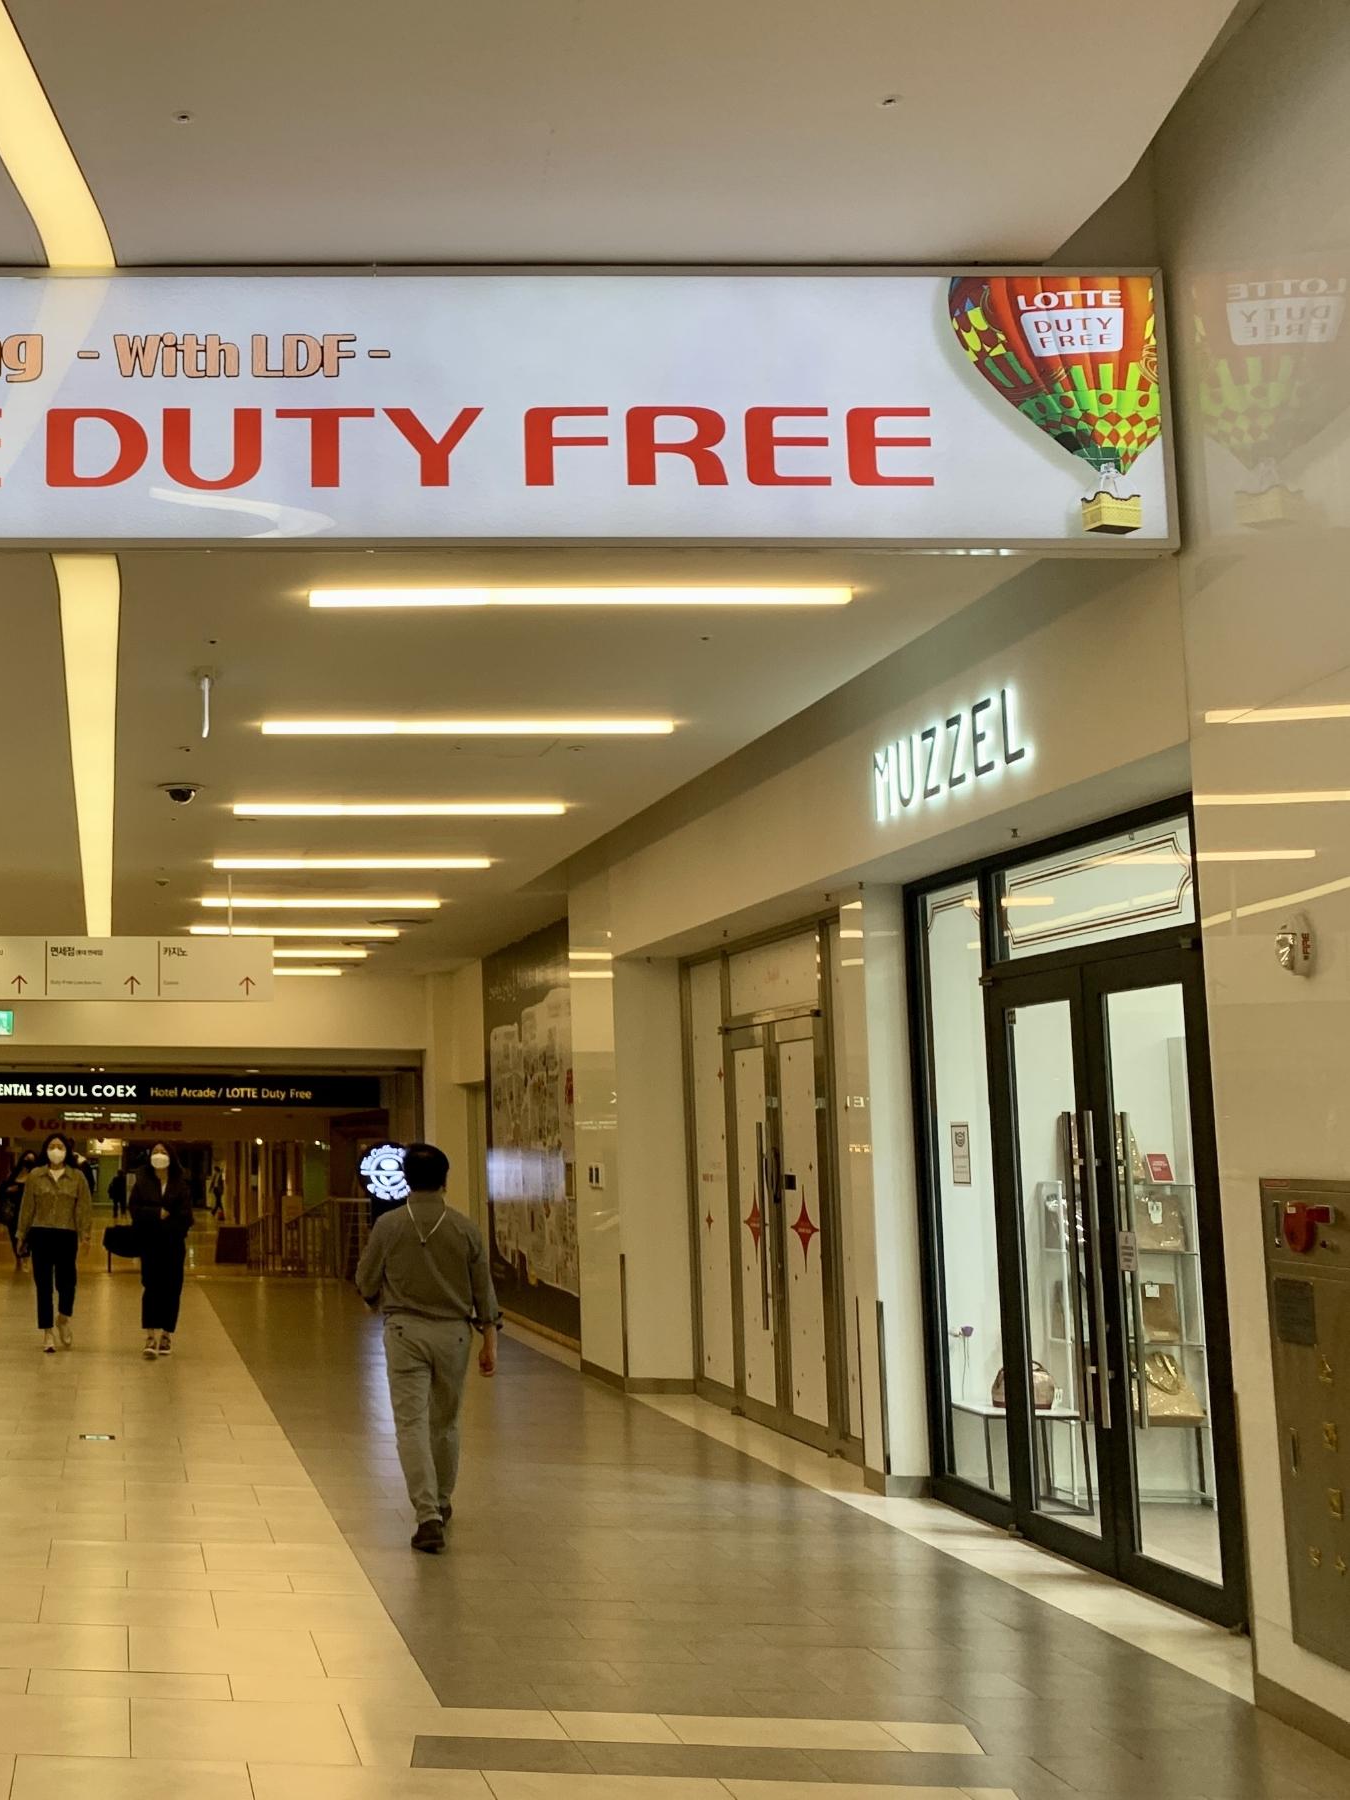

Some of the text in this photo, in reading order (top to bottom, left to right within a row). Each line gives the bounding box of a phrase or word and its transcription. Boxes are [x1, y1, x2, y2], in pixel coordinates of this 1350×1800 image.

[1017, 289, 1122, 311] LOTTE
[1033, 317, 1113, 334] DUTY
[1039, 333, 1113, 349] FREE
[113, 332, 240, 379] With
[45, 406, 485, 491] DUTY
[523, 405, 936, 488] FREE
[872, 687, 1028, 822] MUZZEL
[162, 946, 188, 957] 카지노
[36, 1083, 88, 1097] SEOUL
[92, 1084, 137, 1098] COEX
[150, 1086, 178, 1097] Hotel
[225, 1087, 258, 1099] LOTTE
[261, 1087, 286, 1101] Duty
[290, 1087, 312, 1100] Free
